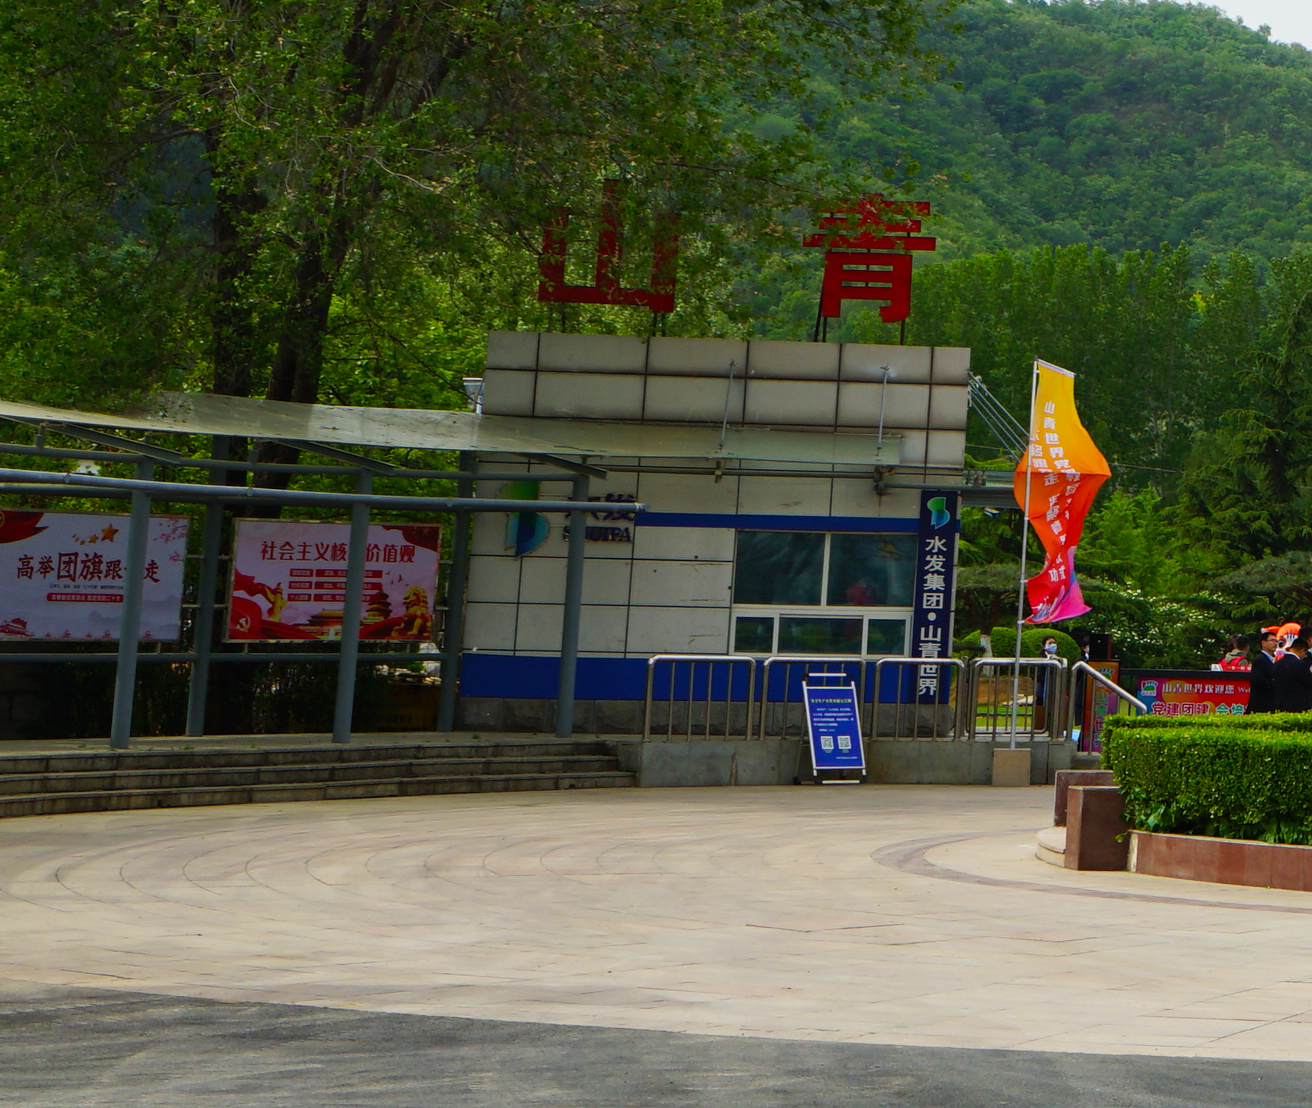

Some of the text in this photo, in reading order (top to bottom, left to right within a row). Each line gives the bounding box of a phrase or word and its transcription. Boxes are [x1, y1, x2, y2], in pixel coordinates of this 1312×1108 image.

[260, 541, 415, 563] 社会主义核价值观
[17, 552, 160, 583] 高举团旗跟走
